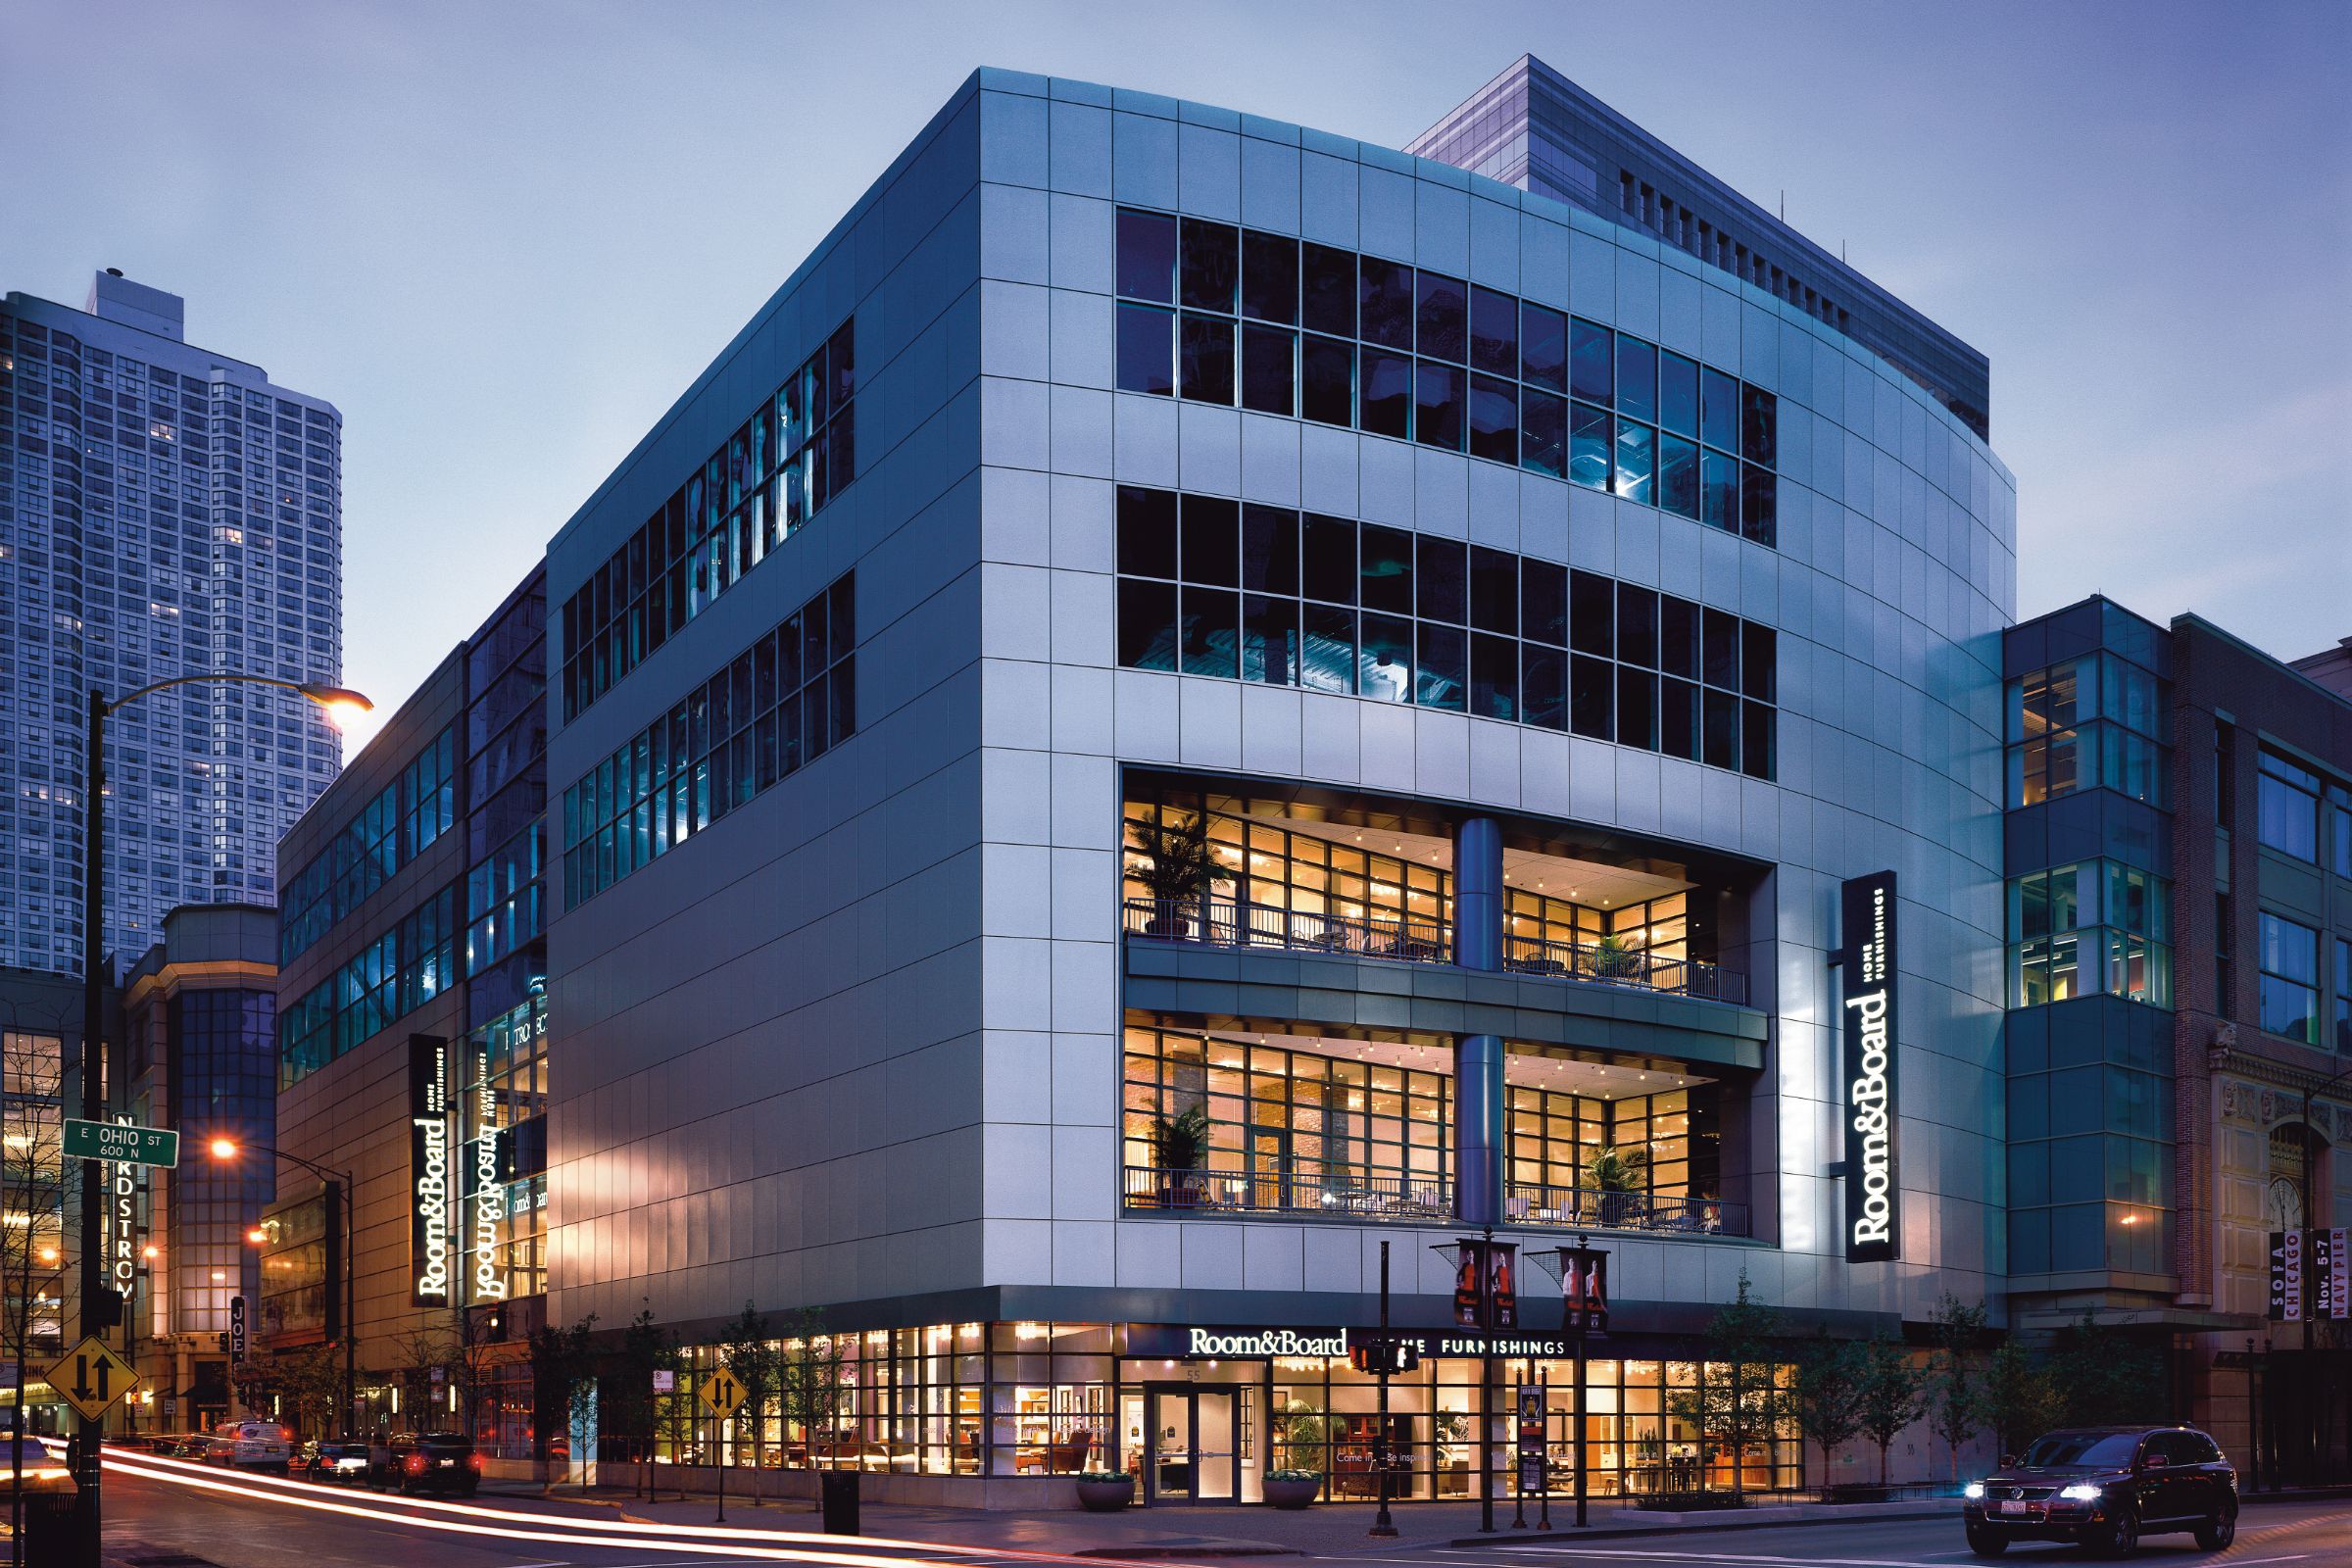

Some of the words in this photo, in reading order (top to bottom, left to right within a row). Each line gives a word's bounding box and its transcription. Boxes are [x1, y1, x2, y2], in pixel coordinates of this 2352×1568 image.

[1874, 888, 1886, 980] FURNISHINGS
[1863, 944, 1873, 982] HOME
[1846, 989, 1889, 1246] Room&Board
[81, 1128, 89, 1138] E
[100, 1128, 139, 1146] OHIO
[147, 1136, 162, 1146] ST
[100, 1146, 123, 1156] 600
[130, 1149, 139, 1158] N
[116, 1116, 134, 1299] NRDSTROM
[414, 1118, 447, 1297] Room&Board
[2317, 1240, 2329, 1265] 5-7
[2332, 1232, 2345, 1269] PIER
[2272, 1247, 2284, 1305] SOFA
[2286, 1235, 2299, 1317] CHICAGO
[2318, 1275, 2329, 1309] Nov.
[2332, 1274, 2345, 1316] NAVY
[232, 1306, 244, 1360] JOE'
[1190, 1327, 1349, 1355] Room&Board
[1442, 1340, 1564, 1354] FURNISHINGS
[1187, 1370, 1200, 1381] 55
[1337, 1451, 1362, 1463] Come
